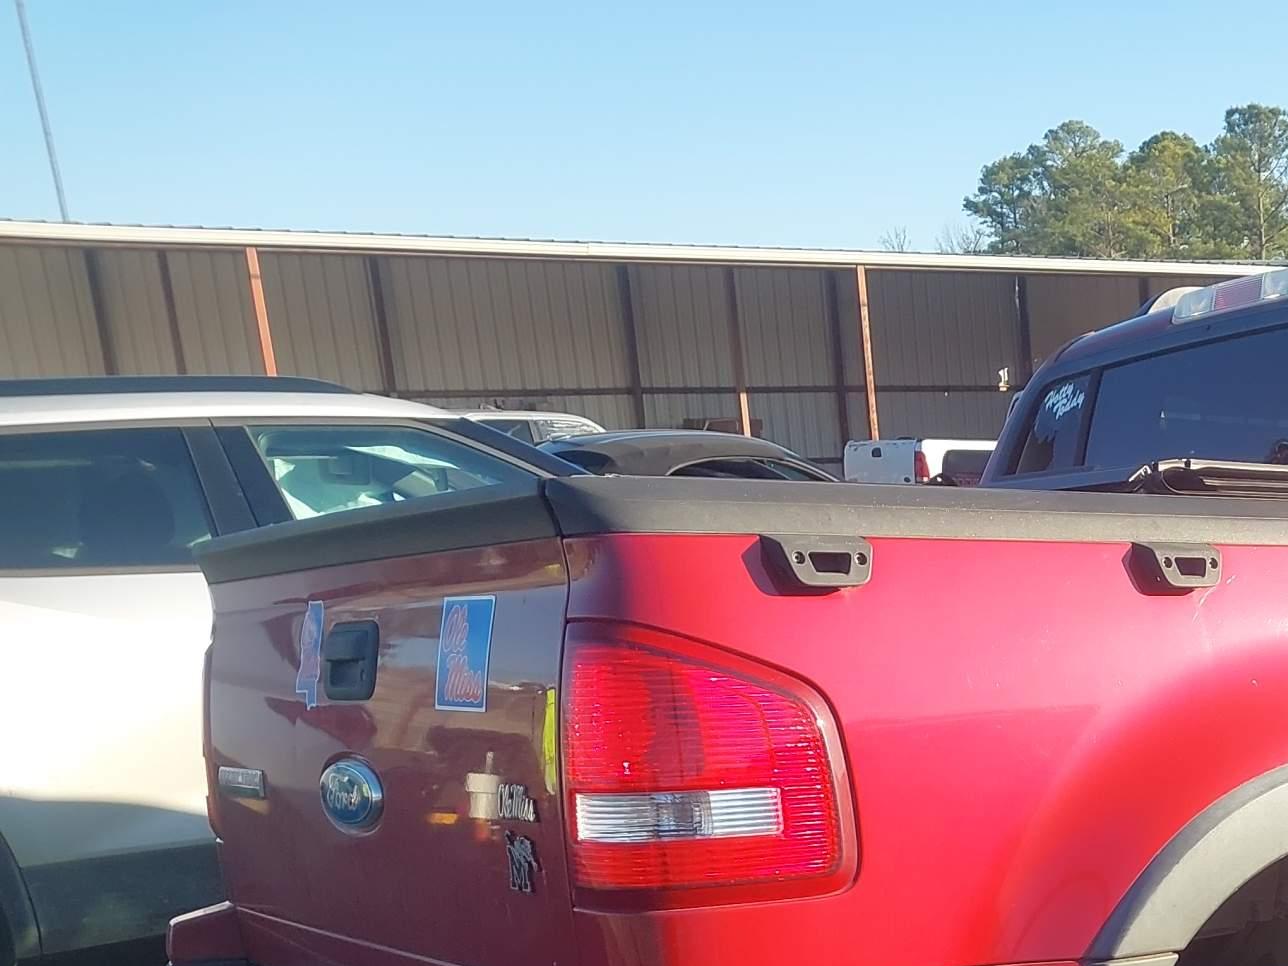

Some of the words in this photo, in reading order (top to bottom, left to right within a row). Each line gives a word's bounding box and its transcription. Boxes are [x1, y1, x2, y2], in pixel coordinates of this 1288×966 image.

[442, 604, 469, 653] Ole
[444, 653, 482, 704] Miss
[326, 772, 360, 810] Ford
